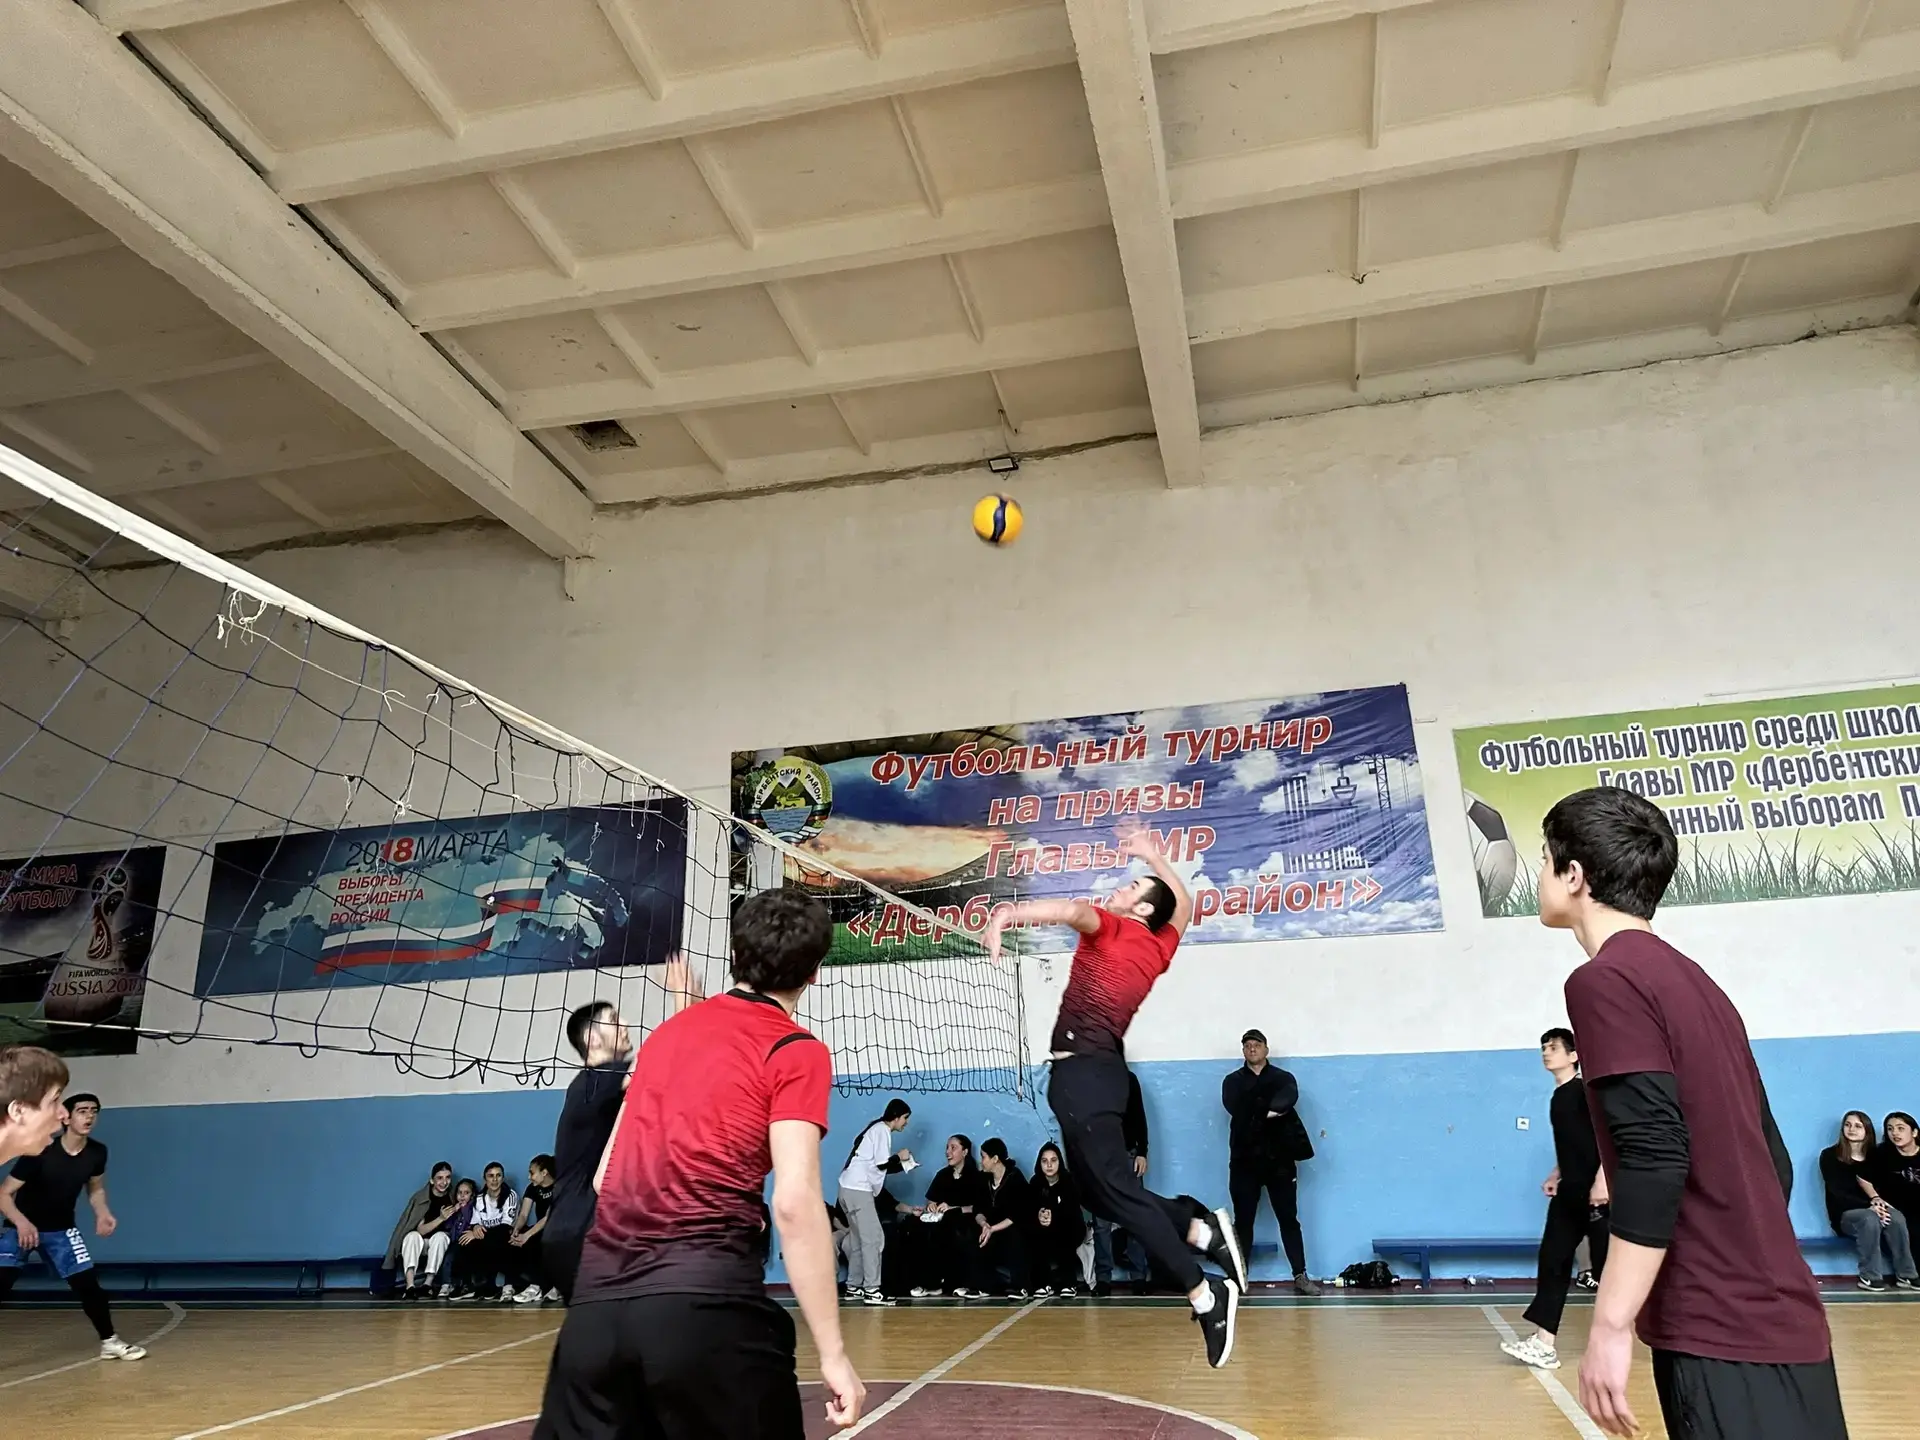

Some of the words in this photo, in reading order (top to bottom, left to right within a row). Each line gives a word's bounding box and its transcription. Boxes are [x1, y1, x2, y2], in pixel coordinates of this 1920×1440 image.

[871, 724, 1148, 792] Футбольный
[1163, 714, 1334, 765] турнир
[1480, 726, 1648, 773] Футбольный
[1654, 720, 1746, 759] турнир
[1757, 712, 1839, 747] среди
[755, 768, 802, 806] ДЕРБЕНТСКИЙ
[805, 774, 822, 800] РАЙОН
[1599, 767, 1684, 798] Главы
[1690, 760, 1735, 793] МР
[987, 793, 1043, 827] на
[1055, 779, 1205, 826] призы
[1670, 797, 1745, 836] нный
[1751, 792, 1885, 830] выборам
[345, 836, 414, 867] 2018
[414, 828, 510, 861] МАРТА
[984, 839, 1132, 879] Главы
[1147, 825, 1217, 864] МР
[30, 863, 78, 886] МИРА
[338, 873, 404, 891] ВЫБОРЫ
[329, 907, 391, 924] РОССИИ
[333, 888, 425, 907] ПРЕЗИДЕНТА
[1191, 872, 1384, 927] район»
[48, 980, 103, 997] RUSSIA
[68, 969, 83, 978] FIFA
